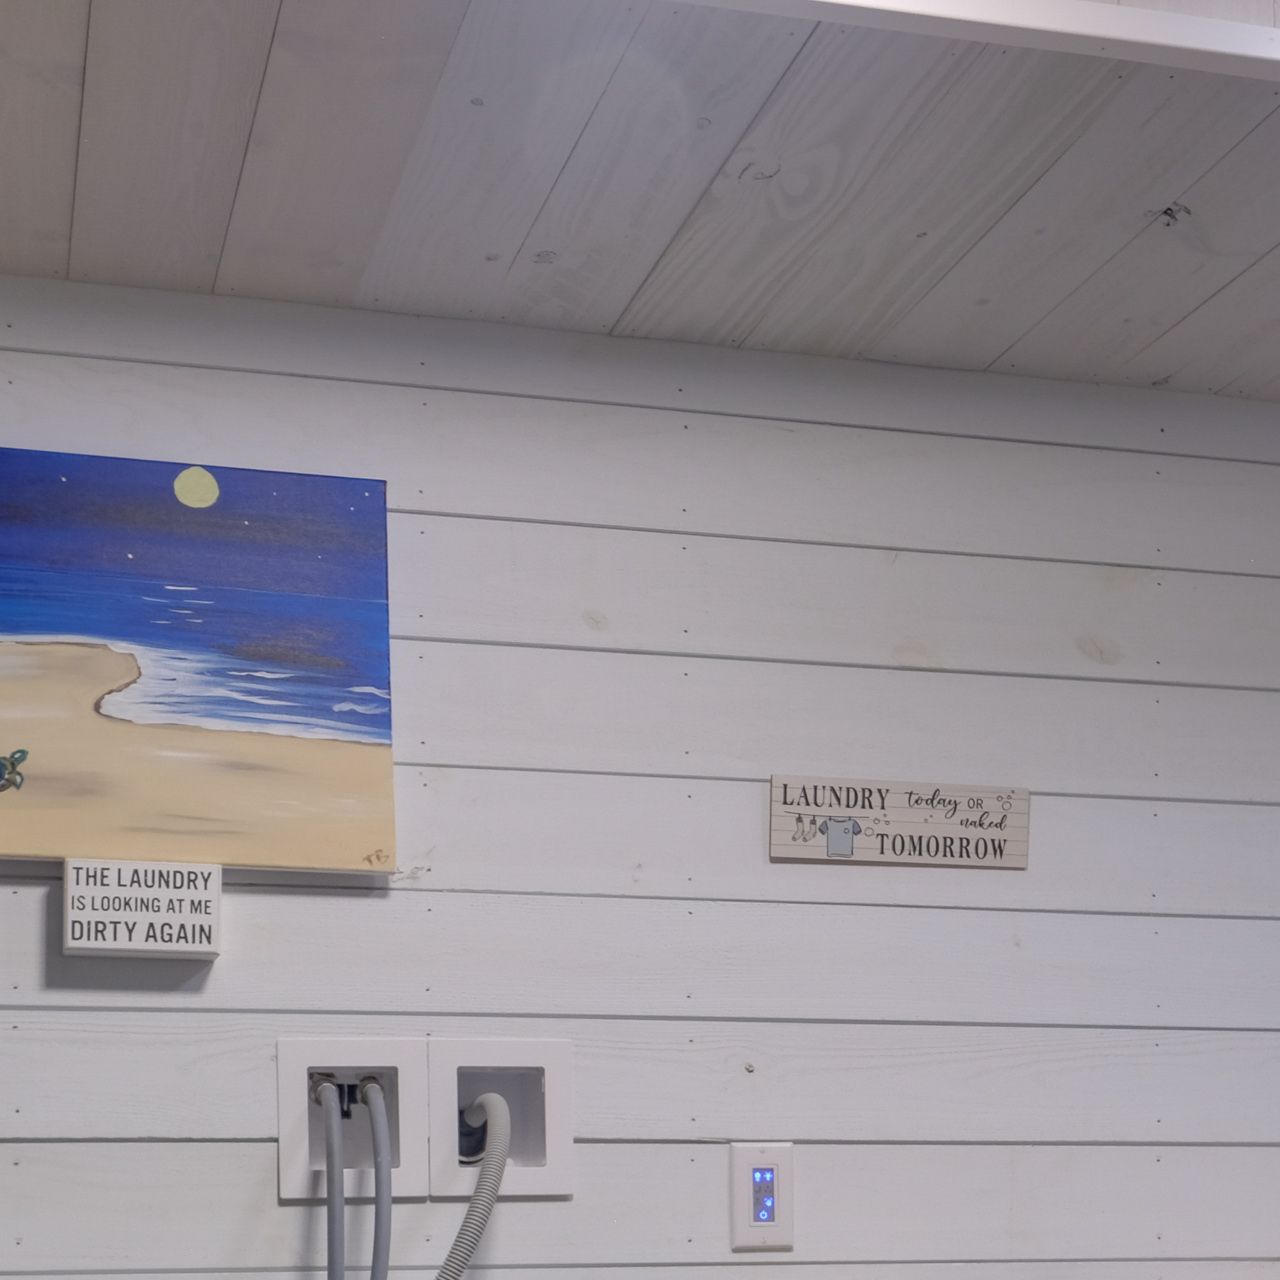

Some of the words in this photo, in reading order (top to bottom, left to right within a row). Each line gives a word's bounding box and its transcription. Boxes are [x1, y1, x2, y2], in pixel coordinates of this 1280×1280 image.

[782, 783, 890, 810] LAUNDRY
[904, 788, 961, 819] today
[967, 798, 984, 810] OR
[959, 811, 1008, 832] naked
[875, 833, 1008, 860] TOMORROW
[72, 866, 110, 887] THE
[117, 867, 213, 891] LAUNDRY
[71, 895, 86, 911] IS
[91, 896, 161, 913] LOOKING
[166, 898, 185, 914] AT
[190, 899, 213, 915] ME
[71, 920, 137, 942] DIRTY
[144, 922, 213, 945] AGAIN
